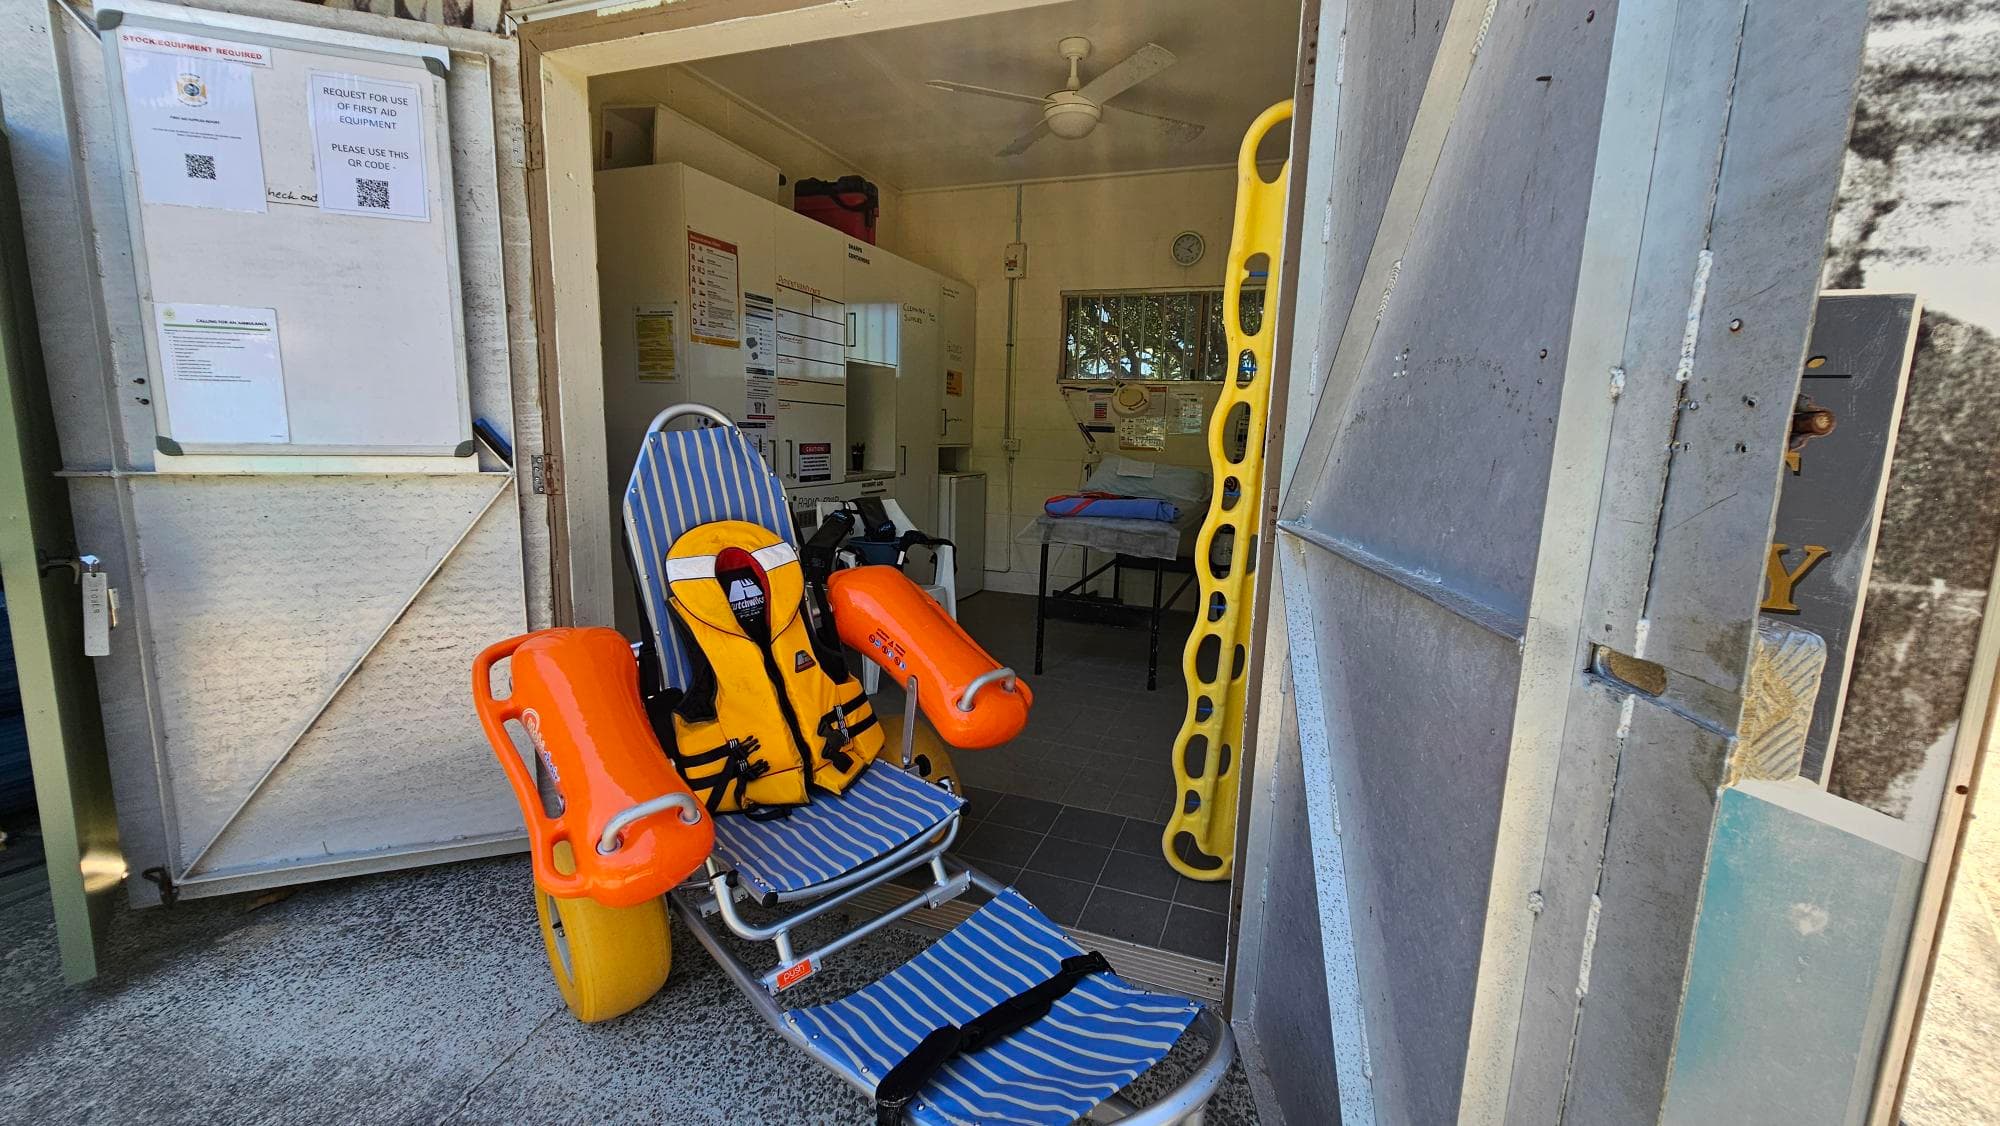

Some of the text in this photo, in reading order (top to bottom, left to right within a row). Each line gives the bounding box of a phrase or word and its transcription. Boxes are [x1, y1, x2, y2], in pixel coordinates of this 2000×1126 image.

[122, 35, 263, 60] STOCK EQUIPMENT REQUIRED
[323, 86, 408, 106] REQUEST FOR USE
[337, 102, 397, 117] OF FIRST AID
[339, 115, 397, 130] EQUIPMENT
[331, 143, 409, 160] PLEASE USE THIS
[347, 158, 362, 168] QR
[365, 160, 391, 171] CODE
[267, 187, 318, 203] heck out
[1760, 543, 1832, 615] Y
[783, 964, 805, 983] push
